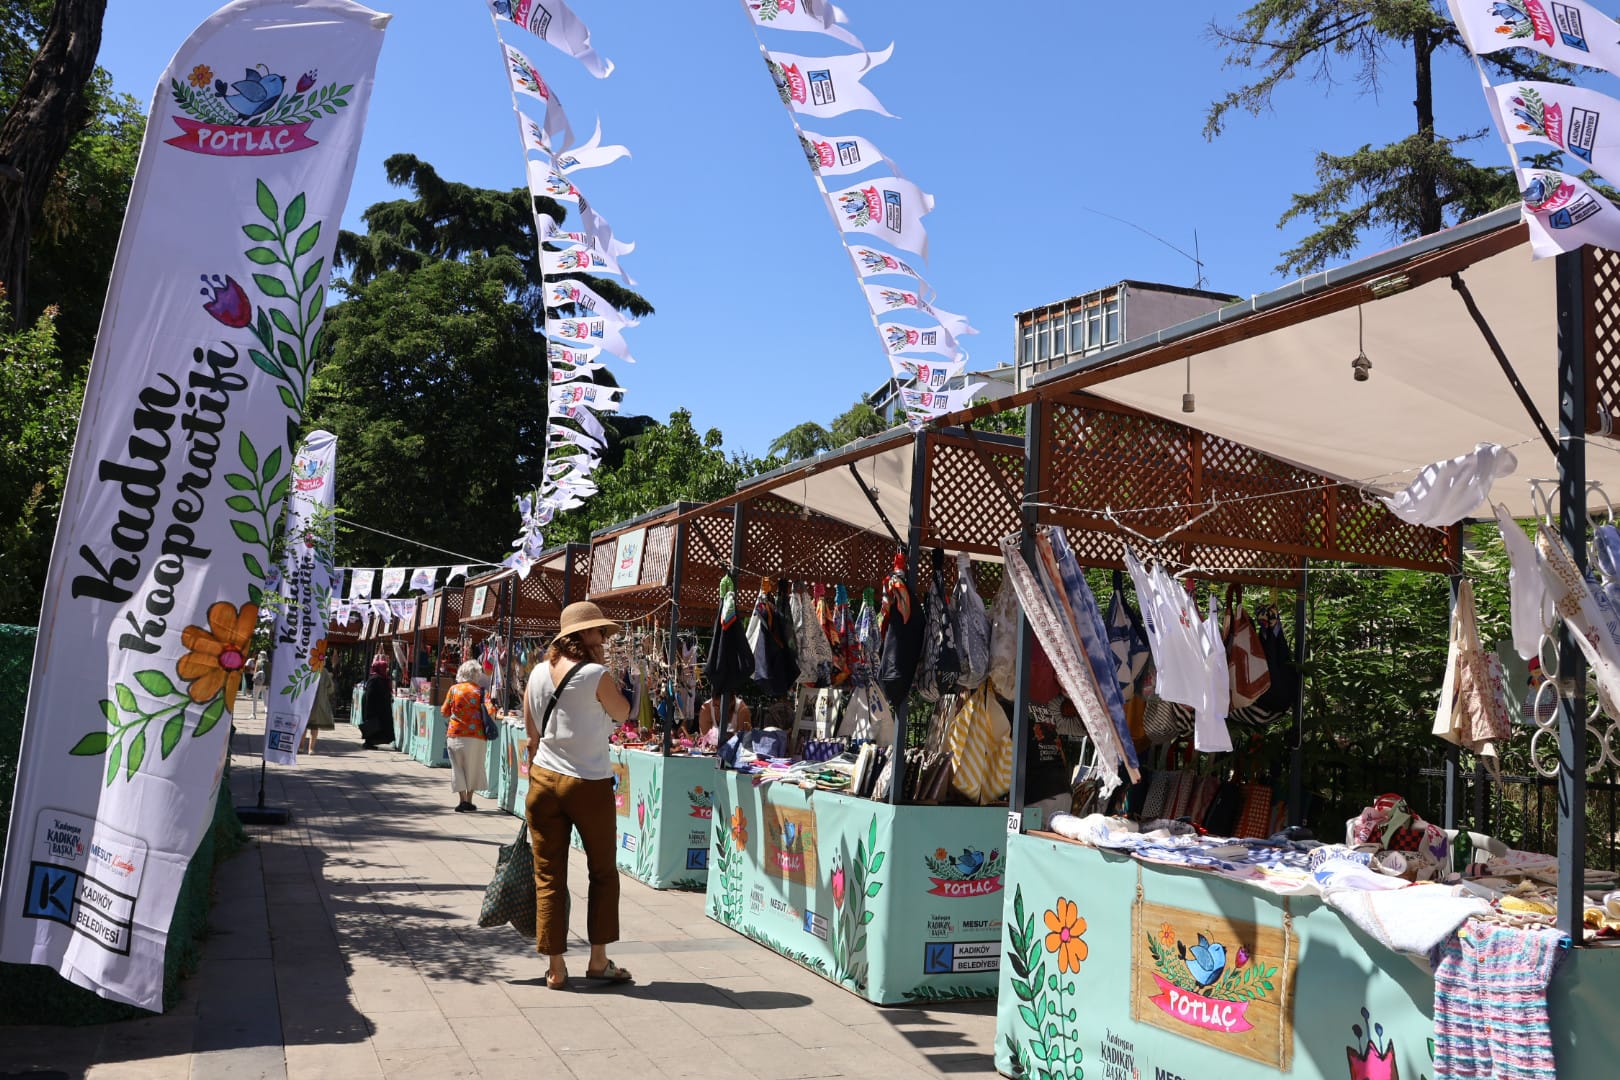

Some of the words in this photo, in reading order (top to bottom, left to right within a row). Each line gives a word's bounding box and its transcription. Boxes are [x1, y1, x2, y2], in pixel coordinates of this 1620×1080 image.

[198, 128, 295, 153] POTLAÇ
[1584, 115, 1595, 146] BELEDİYESİ
[72, 373, 181, 604] Kadın
[119, 341, 248, 655] Kooperatifi
[1008, 817, 1018, 830] 20
[91, 844, 113, 863] MESUT
[39, 871, 68, 915] K
[81, 884, 113, 911] KADIKÖY
[944, 880, 993, 895] POTLAÇ
[77, 911, 120, 945] BELEDİYESİ
[962, 920, 988, 928] MESUT
[930, 946, 950, 970] K
[958, 946, 991, 954] KADIKÖY
[958, 959, 998, 970] BELEDİYESİ
[1169, 990, 1237, 1032] POTLAÇ
[1105, 1027, 1134, 1053] Kadınsan
[1100, 1041, 1135, 1073] KADIKÖY
